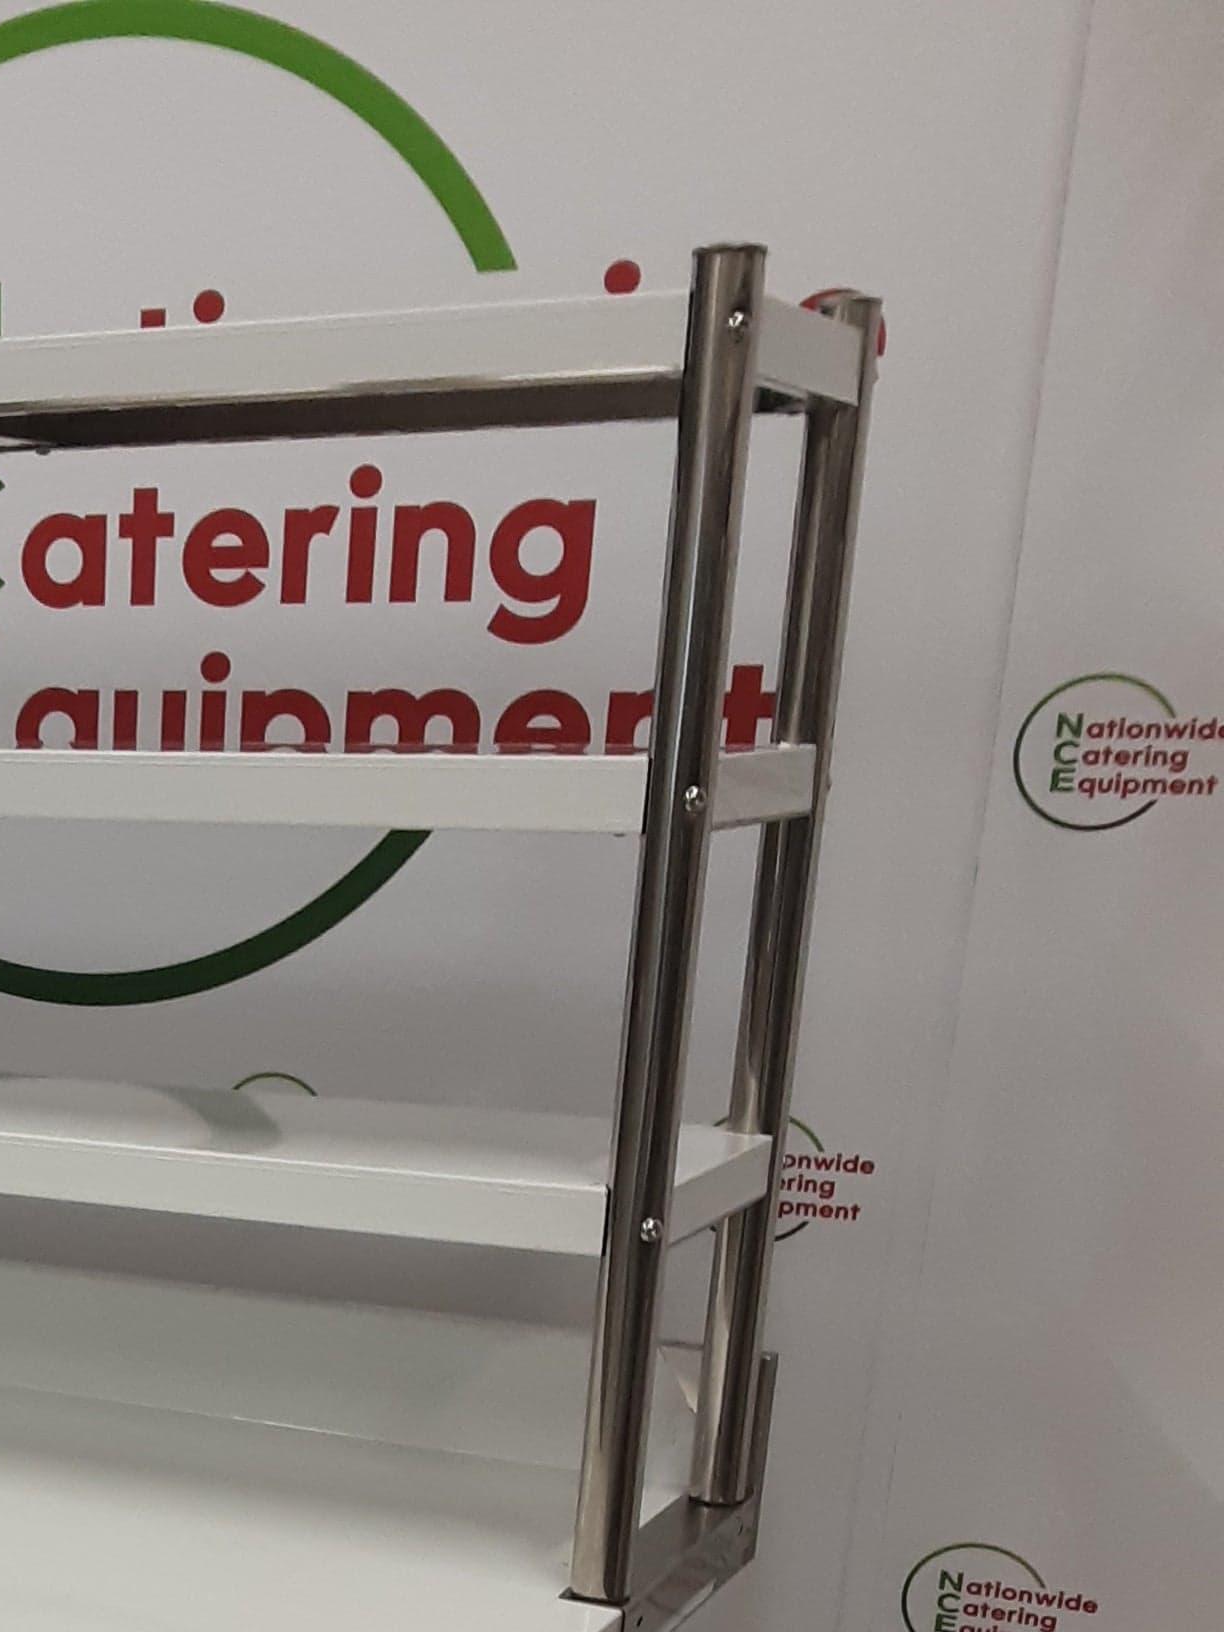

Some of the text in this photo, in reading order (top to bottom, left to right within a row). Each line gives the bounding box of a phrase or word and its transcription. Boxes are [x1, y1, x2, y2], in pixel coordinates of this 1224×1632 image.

[1056, 712, 1224, 740] Nationwid
[1053, 740, 1189, 773] Catering
[1049, 767, 1218, 799] Equipment
[783, 1153, 875, 1175] onwide
[778, 1201, 861, 1221] pment
[938, 1569, 1097, 1614] Nationwide
